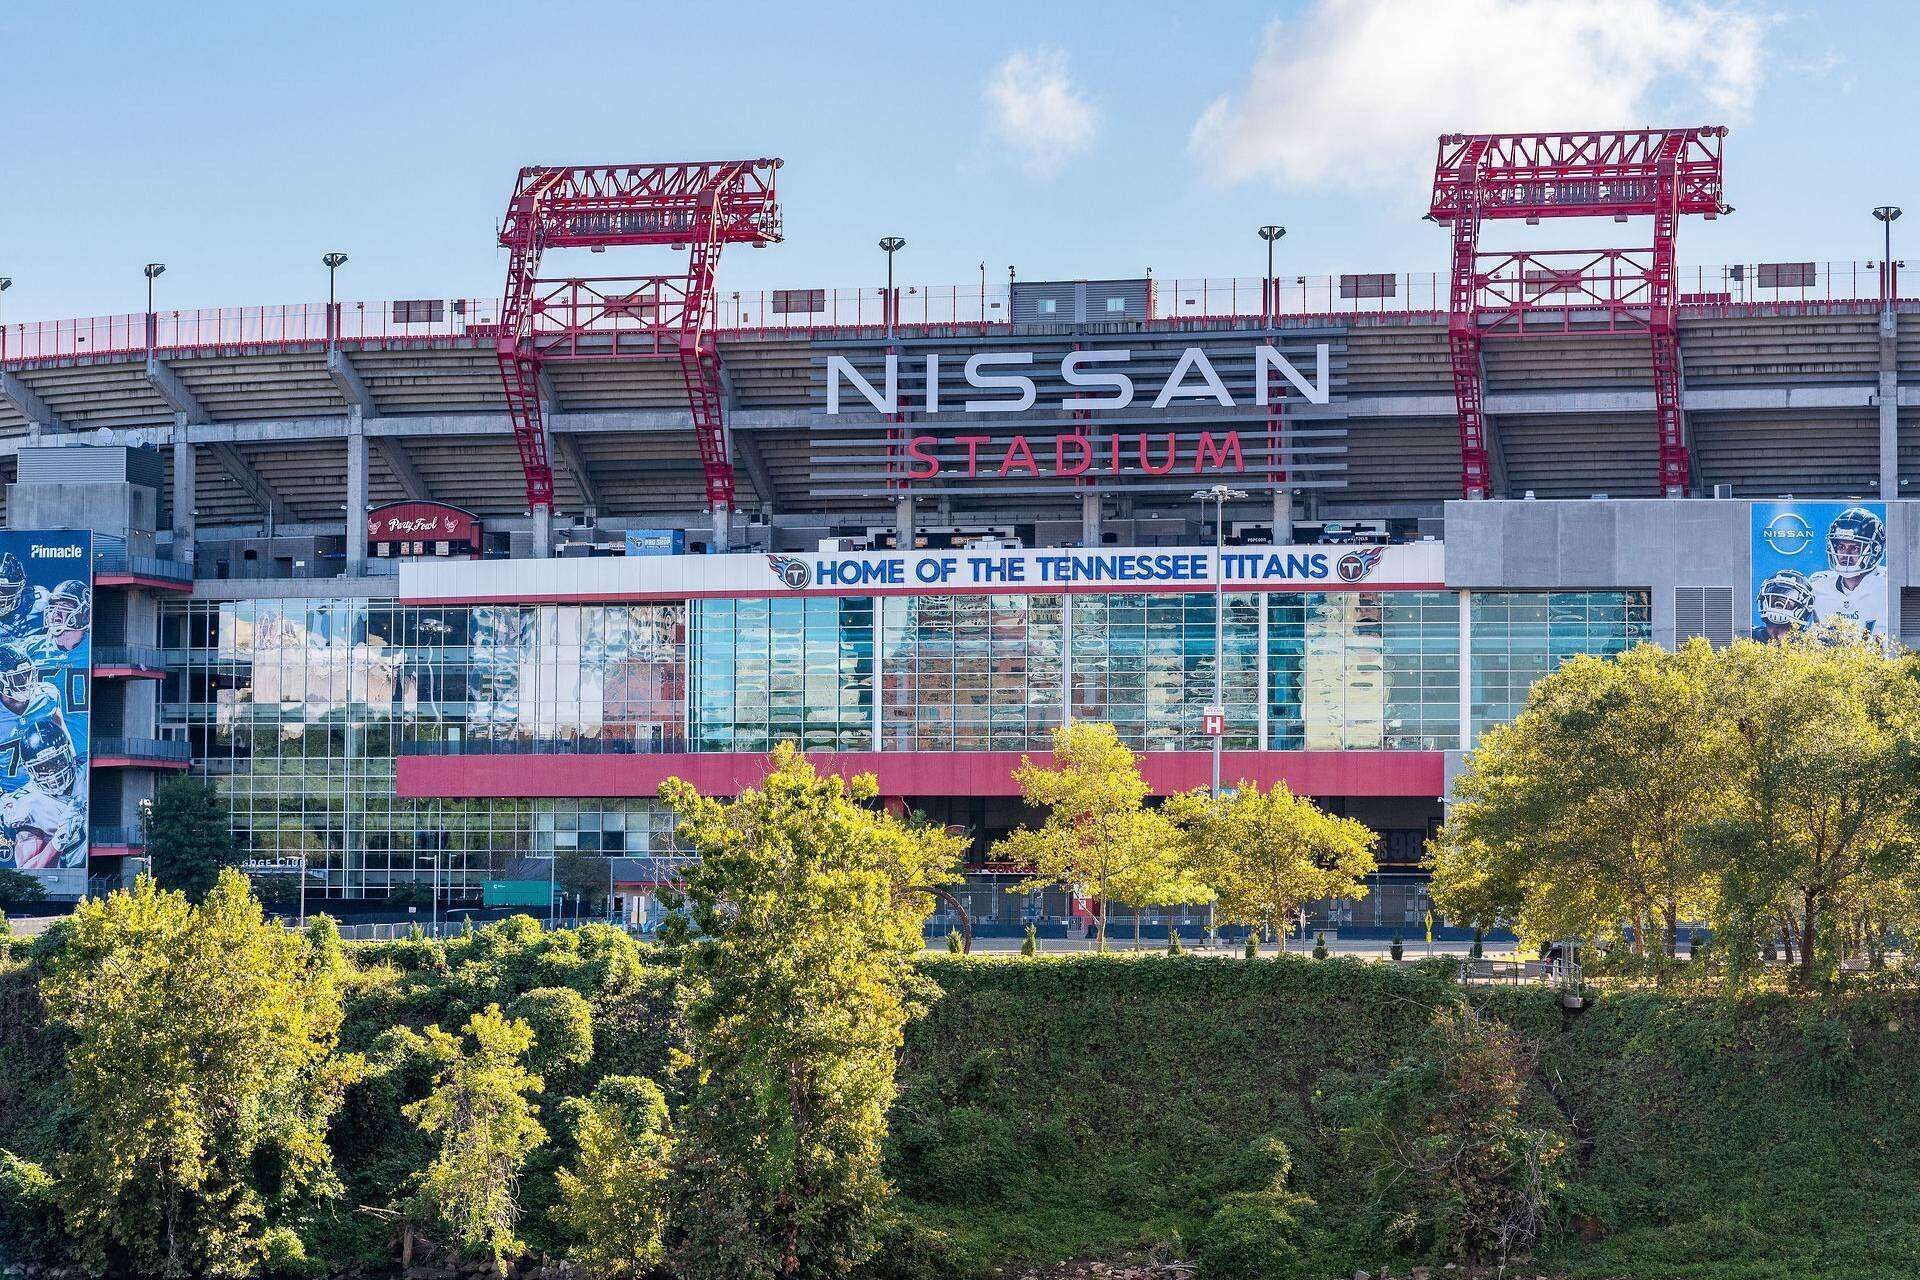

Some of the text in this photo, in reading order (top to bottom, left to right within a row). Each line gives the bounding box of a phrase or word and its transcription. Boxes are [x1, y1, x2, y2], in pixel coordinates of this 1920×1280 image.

[826, 343, 1331, 415] NISSAN
[907, 430, 1246, 479] STADIUM
[388, 516, 438, 534] Party Fowl
[1763, 530, 1814, 538] NISSAN
[31, 544, 83, 559] Pinnacle
[816, 553, 1329, 585] HOME OF THE TENNESSEE TITANS
[1206, 716, 1221, 734] H
